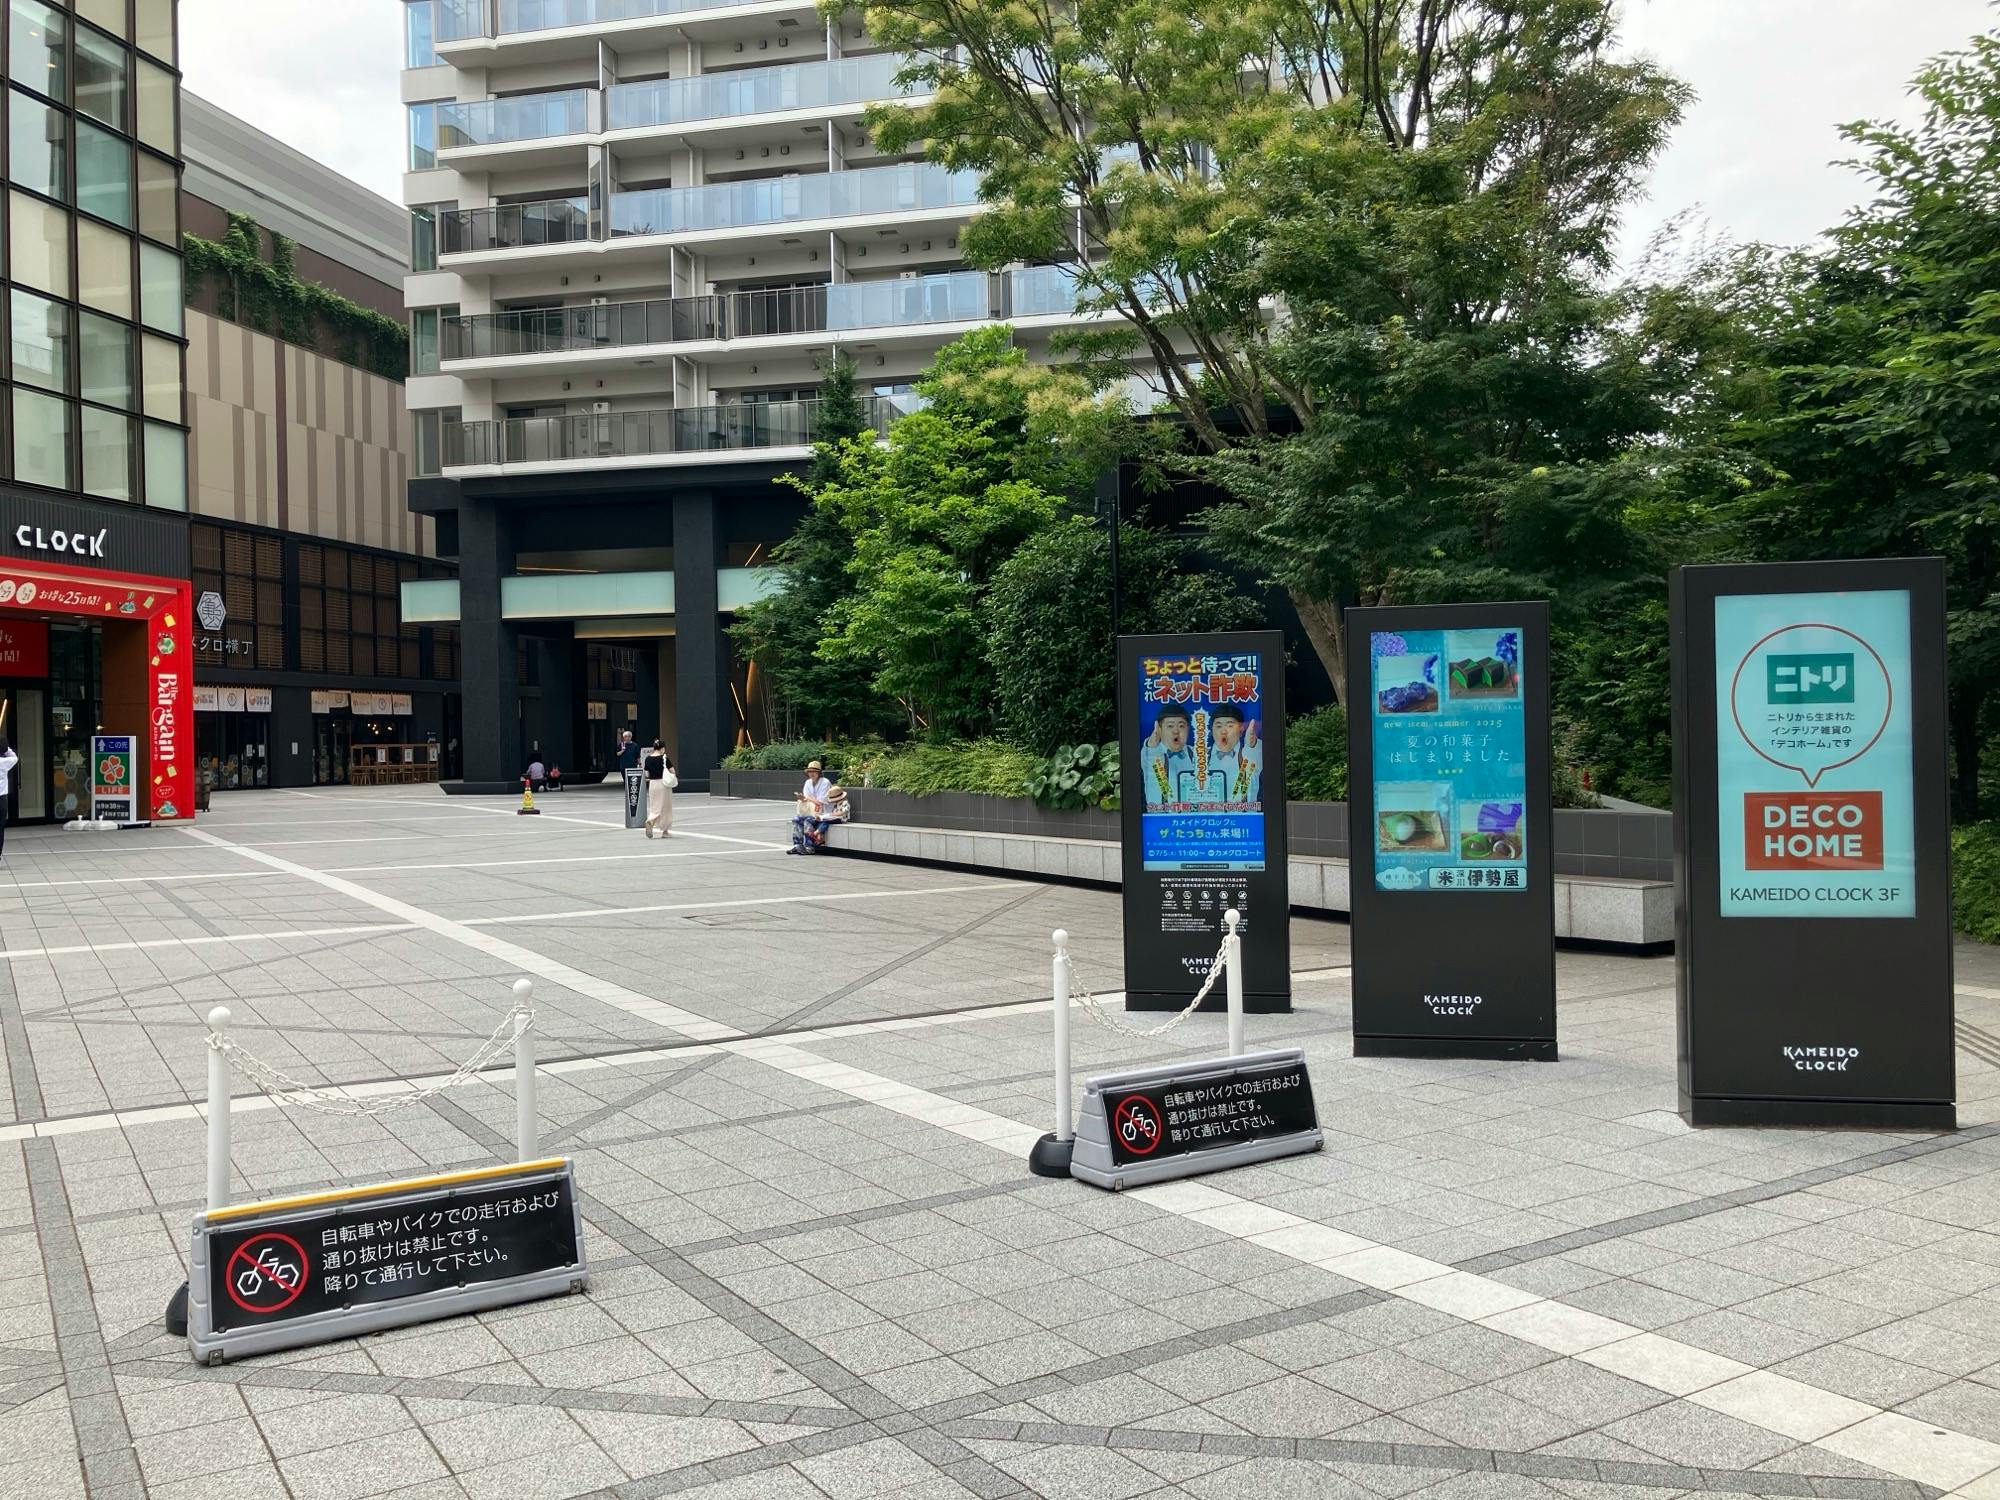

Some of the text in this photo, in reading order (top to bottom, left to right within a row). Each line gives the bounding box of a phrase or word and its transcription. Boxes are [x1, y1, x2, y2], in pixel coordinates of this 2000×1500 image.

[15, 524, 107, 558] CLOCK
[1144, 655, 1257, 675] ちょっと待って!!
[1775, 665, 1847, 692] ニトリ
[1153, 672, 1259, 705] ネット詐欺
[152, 672, 177, 761] Bargain
[1476, 719, 1502, 728] 2025
[1768, 712, 1856, 722] ニトリから生まれた
[1771, 725, 1852, 735] インテリア雑貨の
[108, 741, 129, 749] この先
[1407, 734, 1493, 748] 夏の和菓子
[1770, 738, 1852, 748] 「デコホーム」です
[1389, 750, 1510, 764] はじまりました
[101, 786, 124, 794] LIFE
[1764, 804, 1863, 828] DECO
[1764, 834, 1863, 857] HOME
[1467, 869, 1520, 887] 伊勢屋
[1730, 887, 1900, 901] KAMEIDO CLOCK 3F
[1424, 994, 1482, 1006] KAMEIDO
[1433, 1004, 1474, 1015] CLOCK
[1783, 1046, 1859, 1060] KAMEIDO
[1795, 1057, 1849, 1071] CLOCK
[1164, 1074, 1300, 1107] 自転車やバイクでの走行および
[1168, 1098, 1262, 1125] 通り抜けは禁止です。
[1171, 1114, 1276, 1143] 降りて通行して下さい。
[321, 1190, 560, 1247] 自転車やバイクでの走行および
[322, 1231, 490, 1270] 通り抜けは禁止です。
[324, 1250, 509, 1294] 降りて通行して下さい。
